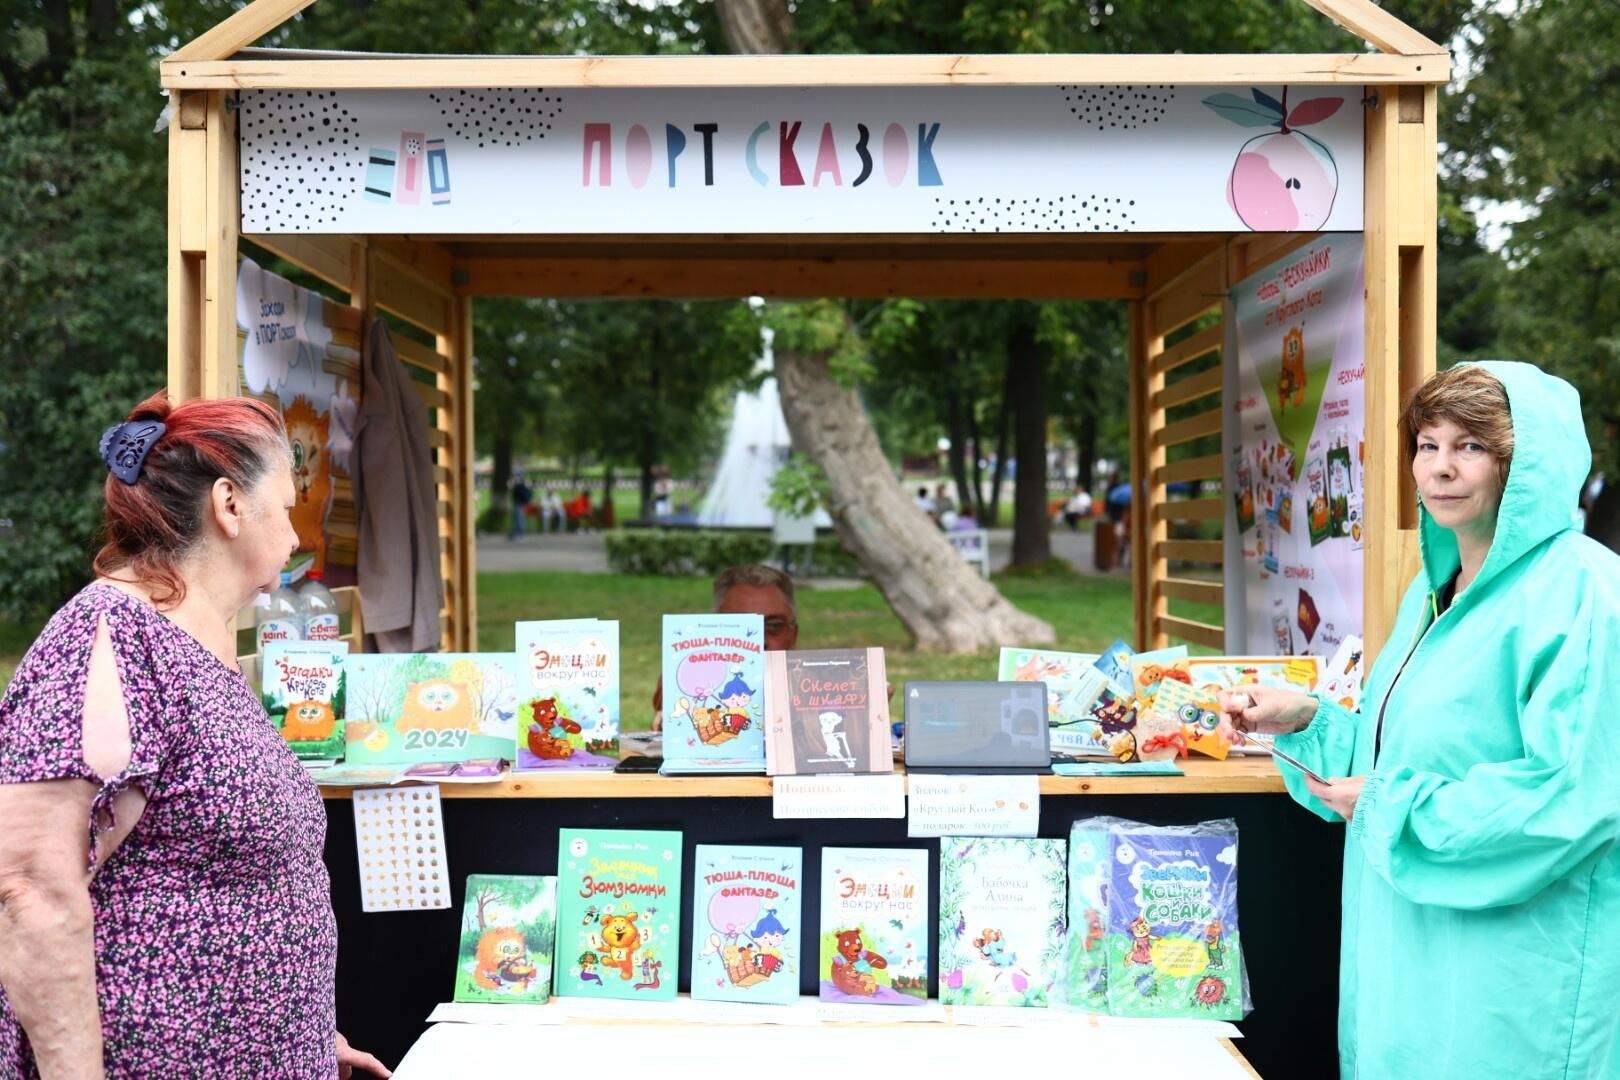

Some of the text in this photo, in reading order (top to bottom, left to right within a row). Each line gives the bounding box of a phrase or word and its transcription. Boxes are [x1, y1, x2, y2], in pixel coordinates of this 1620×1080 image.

[582, 121, 943, 188] ПОРТ СКАЗОК
[263, 631, 287, 640] saint
[671, 637, 761, 654] ТЮША-ПЛЮША
[688, 652, 745, 664] ФАНТАЗЁР
[280, 664, 333, 682] Загадки
[537, 670, 606, 681] вокруг нас
[800, 678, 859, 693] Скелет
[809, 693, 867, 706] шкафу
[404, 729, 468, 750] 2024
[579, 875, 666, 899] Зюмзюмки
[703, 870, 797, 890] ТЮША-ПЛЮША
[721, 887, 779, 900] ФАНТАЗЁР
[842, 900, 913, 912] вокруг нас
